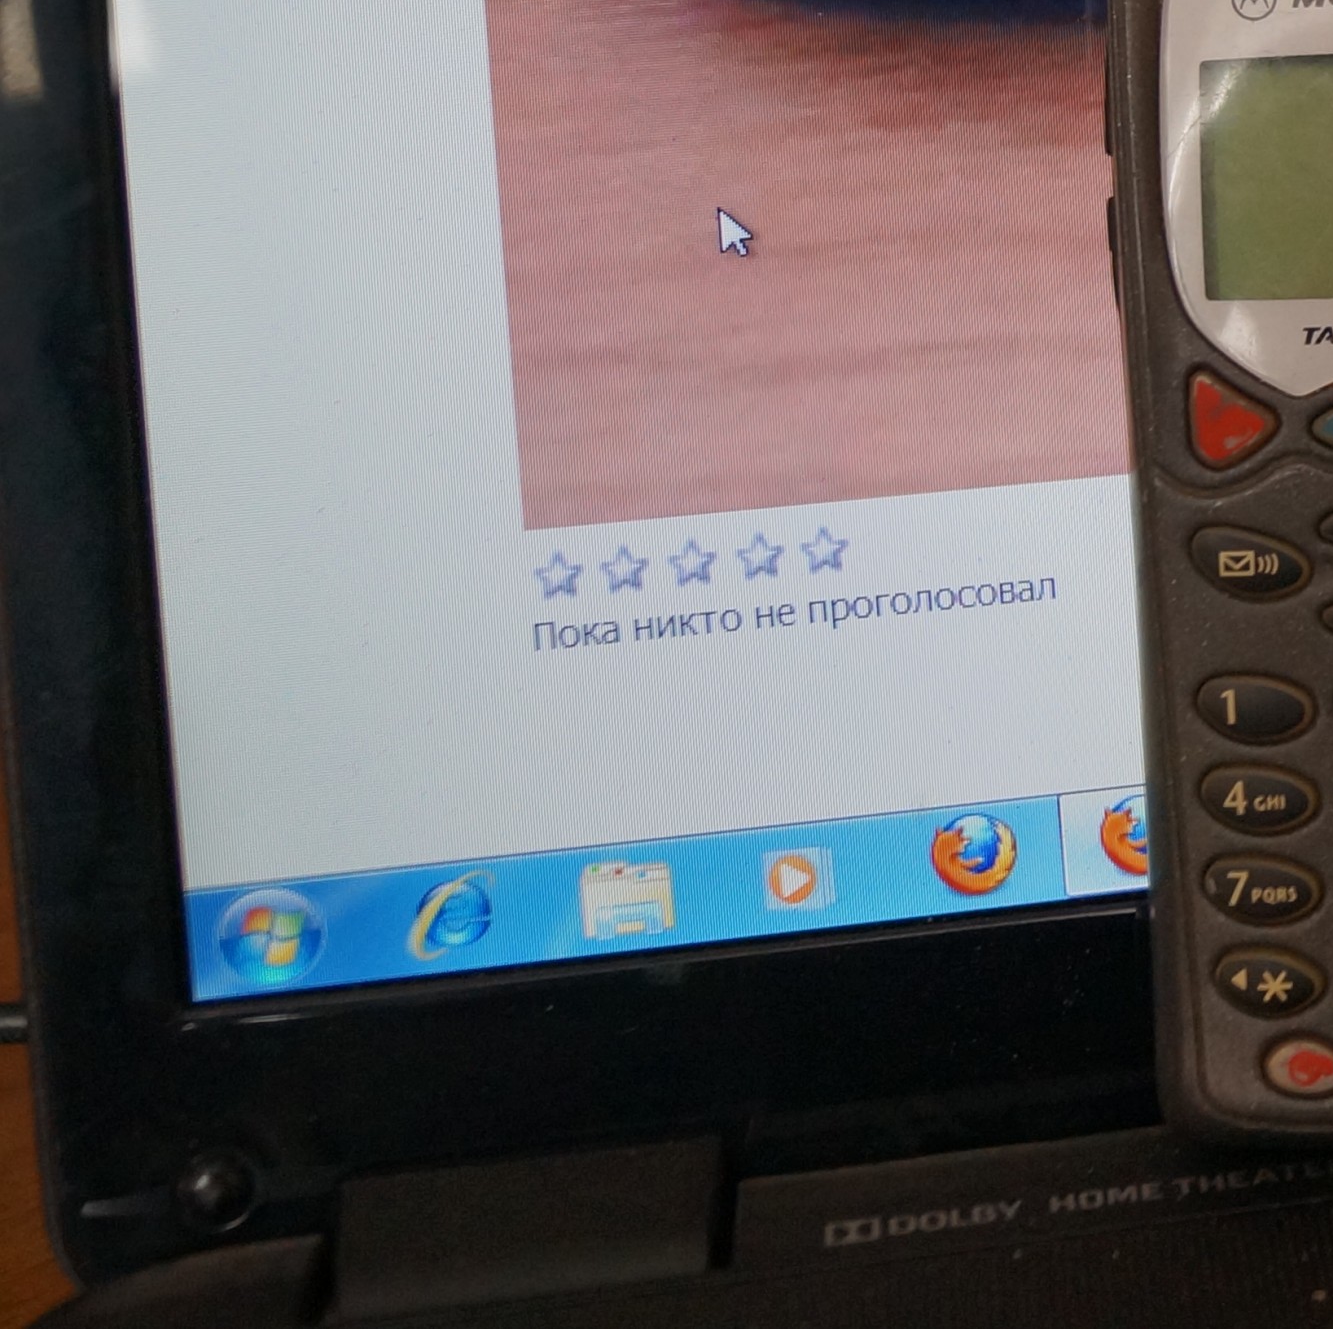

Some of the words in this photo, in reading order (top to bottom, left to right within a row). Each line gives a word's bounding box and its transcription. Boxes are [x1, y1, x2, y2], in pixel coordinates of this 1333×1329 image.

[531, 618, 622, 652] Пока
[632, 606, 743, 643] никто
[754, 599, 797, 631] не
[807, 575, 1058, 632] проголосовал
[1218, 688, 1237, 726] 1
[1222, 780, 1248, 816] 4
[1252, 793, 1287, 811] GHI
[1226, 871, 1249, 907] 7
[1250, 886, 1298, 905] PQRS
[888, 1199, 1023, 1237] DOLBY
[1049, 1181, 1166, 1214] HOME
